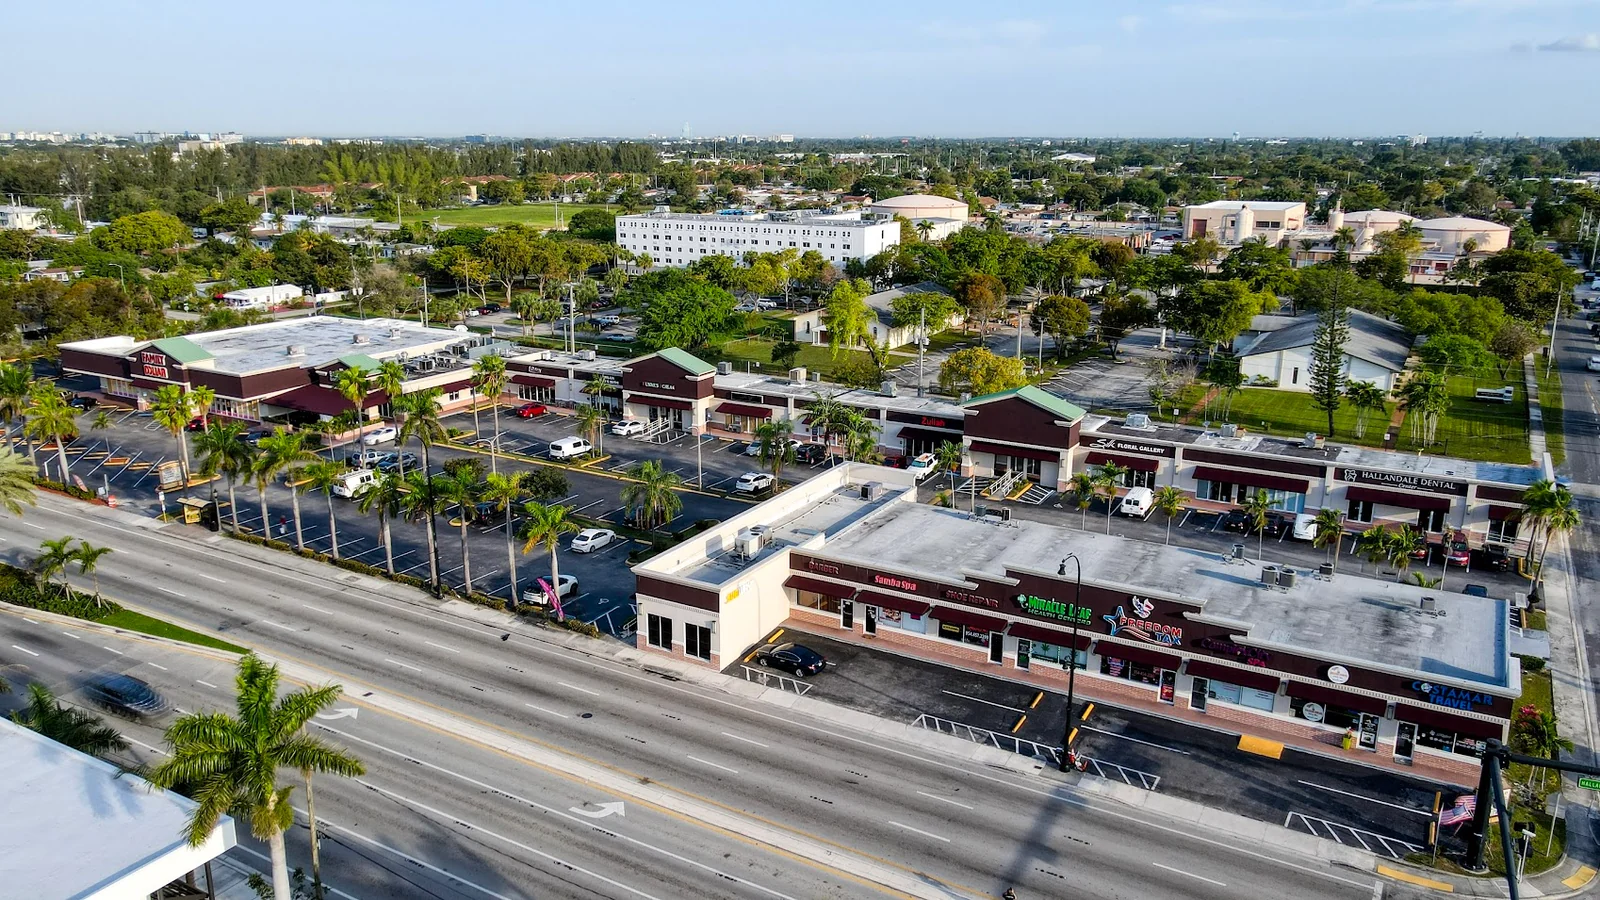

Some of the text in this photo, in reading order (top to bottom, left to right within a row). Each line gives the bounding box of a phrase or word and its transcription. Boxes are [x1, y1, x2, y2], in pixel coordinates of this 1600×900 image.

[141, 351, 166, 365] FAMILY
[1117, 442, 1139, 452] FLORAL
[1139, 446, 1165, 454] GALLERY
[1361, 471, 1456, 490] HALLANDALE DENTAL
[808, 560, 840, 575] BARBER
[874, 574, 917, 592] Samba Spa
[945, 589, 999, 608] SHOE REPAIR
[1027, 608, 1056, 618] HEALTH
[1120, 617, 1183, 639] FREEDOM
[1155, 631, 1182, 645] TAX
[1429, 693, 1473, 710] TRAVEL
[1581, 780, 1600, 788] HALLA
